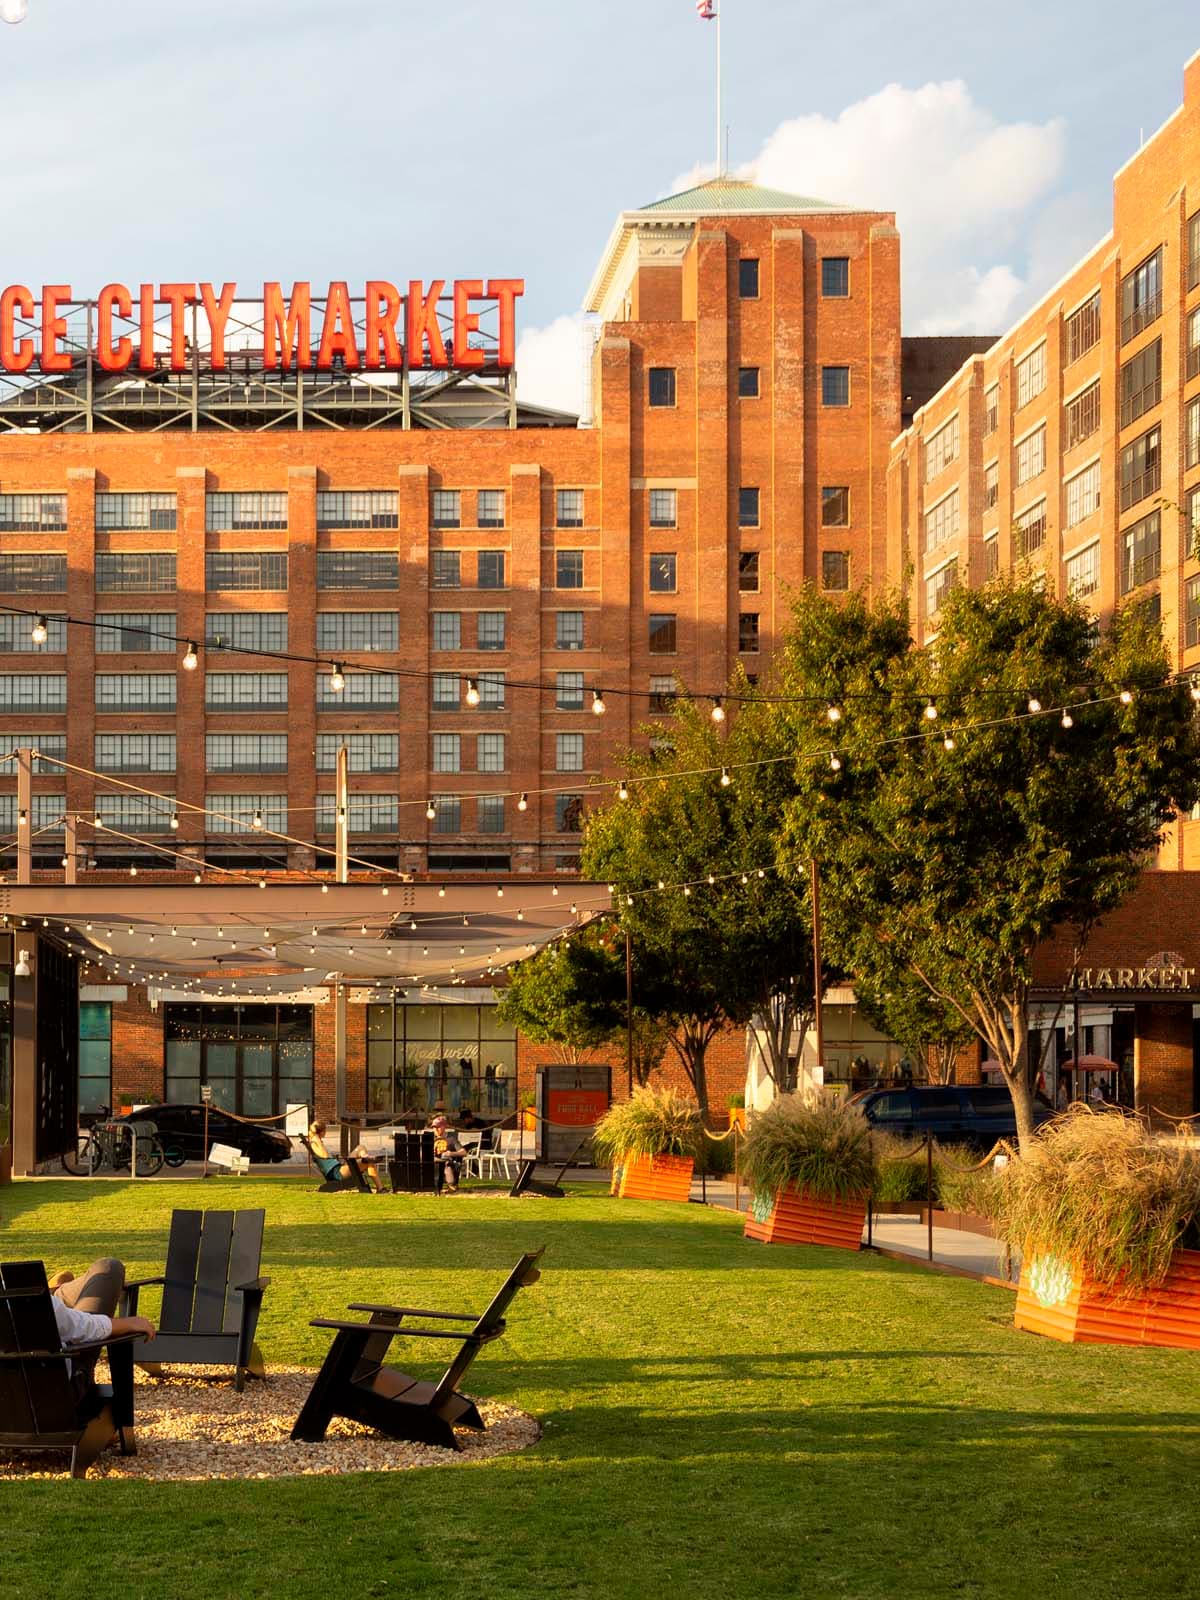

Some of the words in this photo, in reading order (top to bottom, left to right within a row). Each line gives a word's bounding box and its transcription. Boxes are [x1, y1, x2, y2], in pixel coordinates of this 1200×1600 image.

[99, 282, 237, 372] CITY
[263, 278, 525, 371] MARKET
[1065, 967, 1196, 989] MARKET
